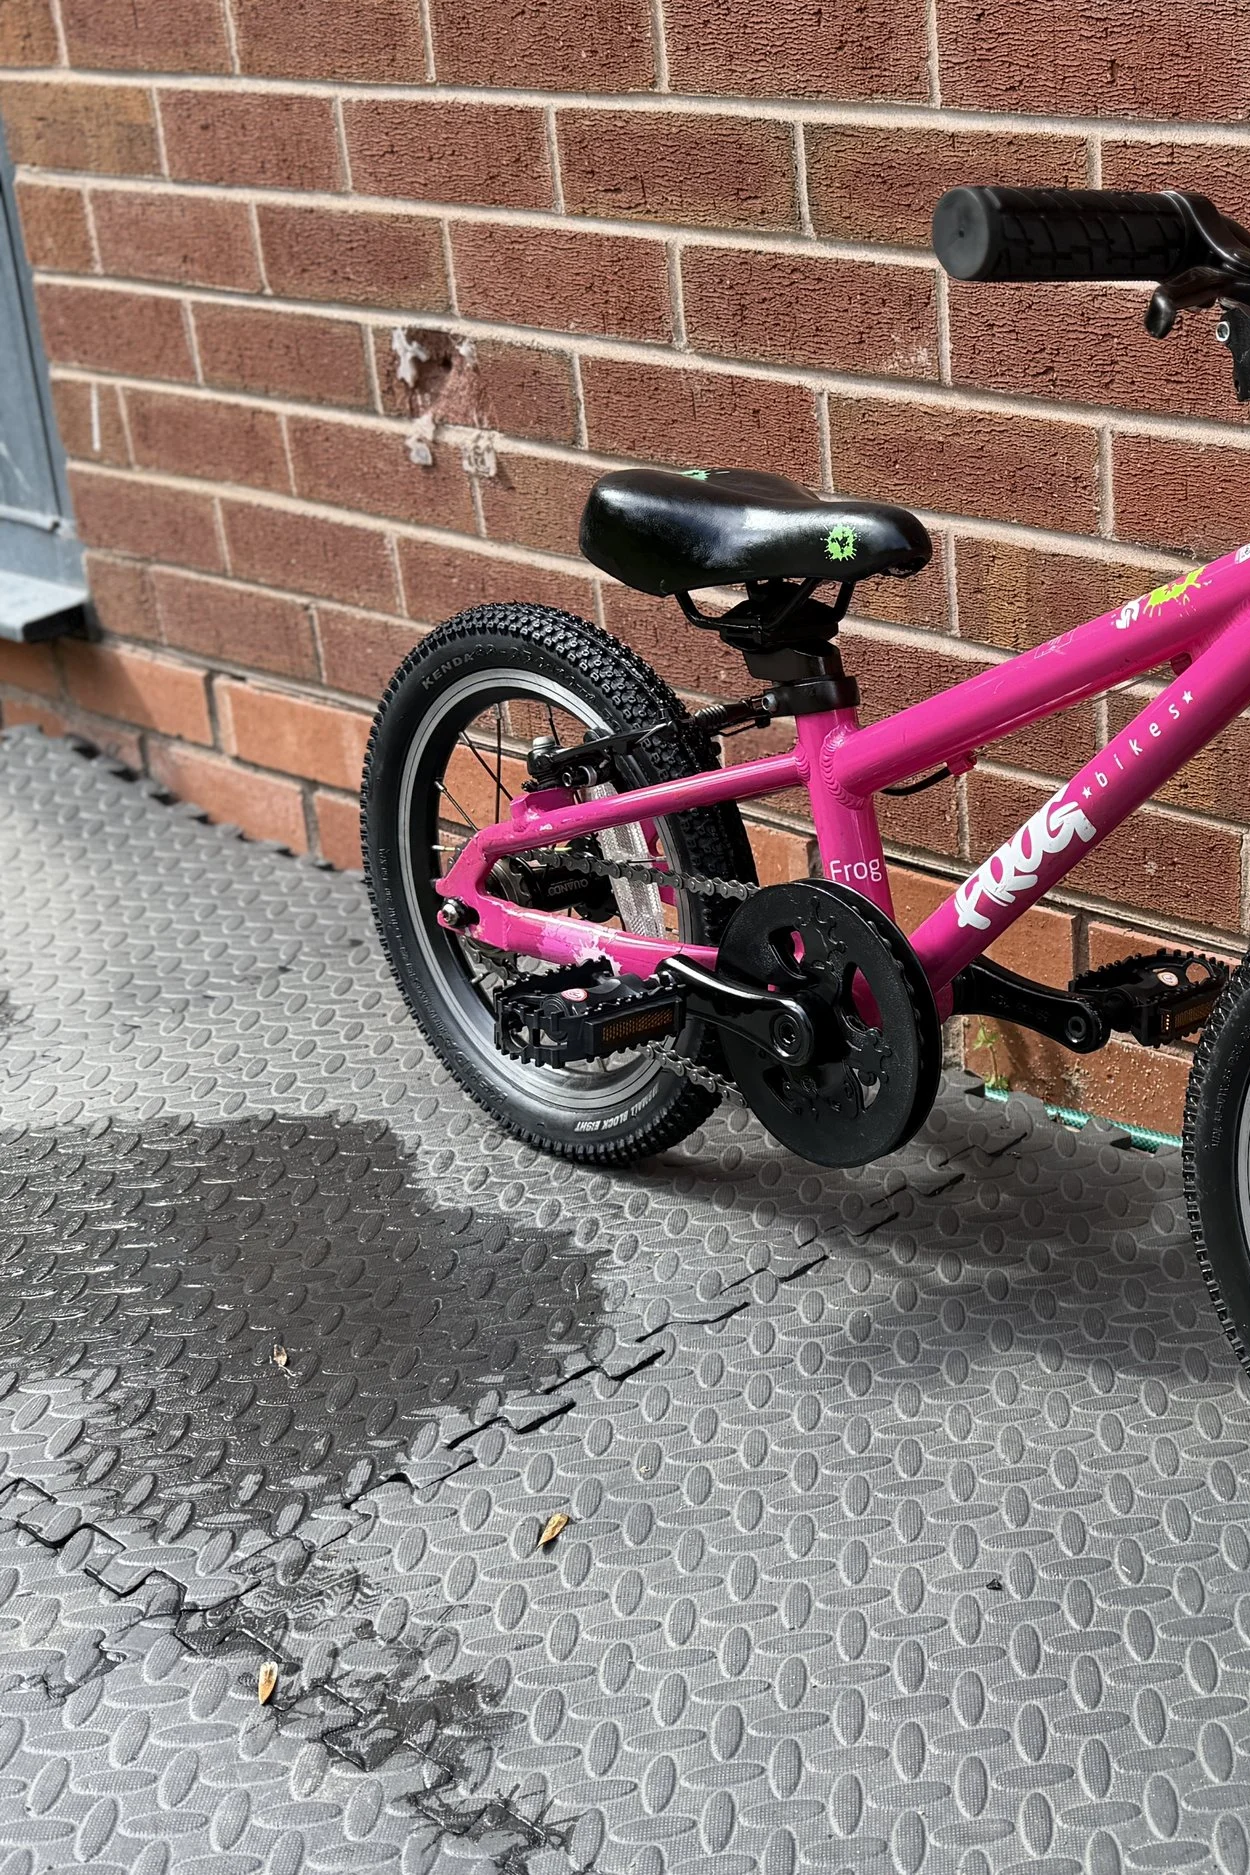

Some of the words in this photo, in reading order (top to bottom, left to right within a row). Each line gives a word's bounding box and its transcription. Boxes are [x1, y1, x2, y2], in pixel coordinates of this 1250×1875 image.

[421, 652, 475, 691] KENDA
[1094, 703, 1181, 790] bikes
[829, 858, 883, 882] Frog
[547, 878, 589, 896] QUANDO
[574, 1120, 602, 1133] EIGHT
[601, 1110, 629, 1131] BLOCK
